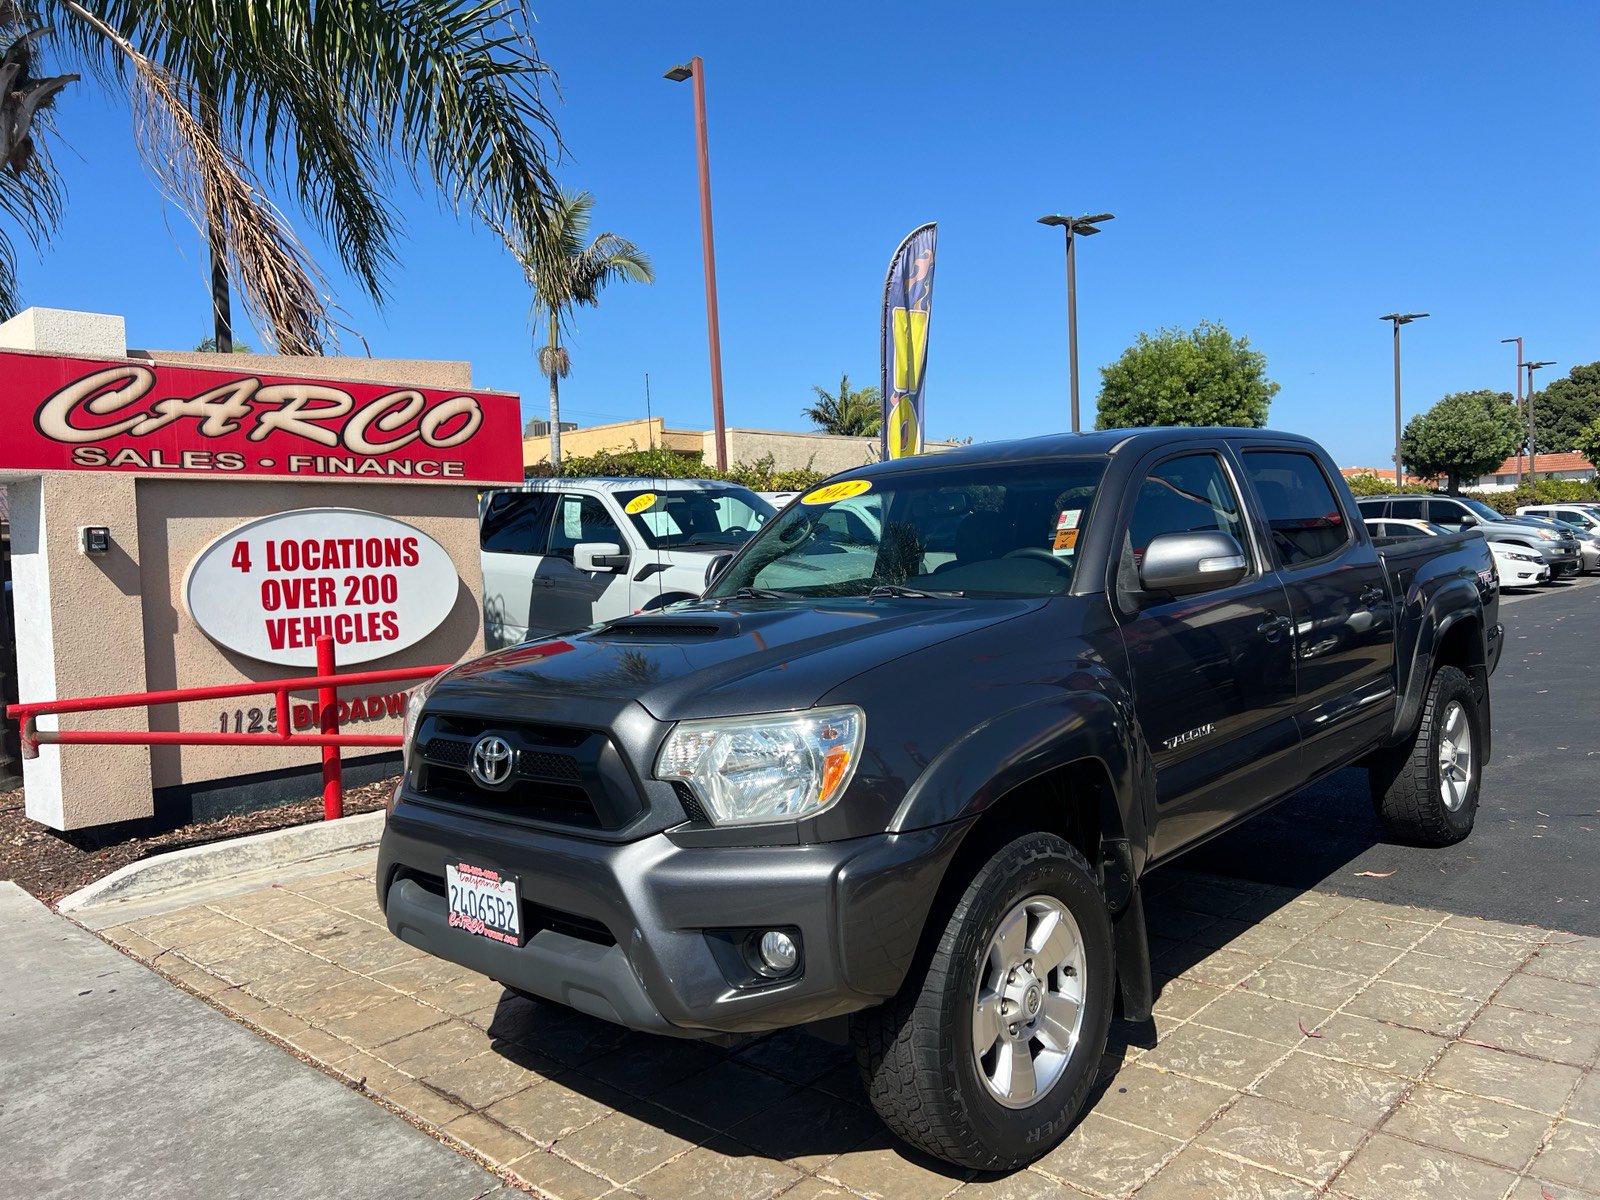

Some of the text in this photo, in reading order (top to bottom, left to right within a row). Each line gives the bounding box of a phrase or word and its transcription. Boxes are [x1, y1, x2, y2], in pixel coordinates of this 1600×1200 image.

[34, 365, 484, 456] CARCO
[71, 446, 466, 478] SALES FINANCE
[809, 482, 862, 501] 2012
[231, 537, 420, 573] 4 LOCATIONS
[261, 574, 398, 612] OVER 200
[265, 610, 400, 651] VEHICLES
[1162, 723, 1217, 750] TACOMA
[450, 884, 516, 932] 24065B2
